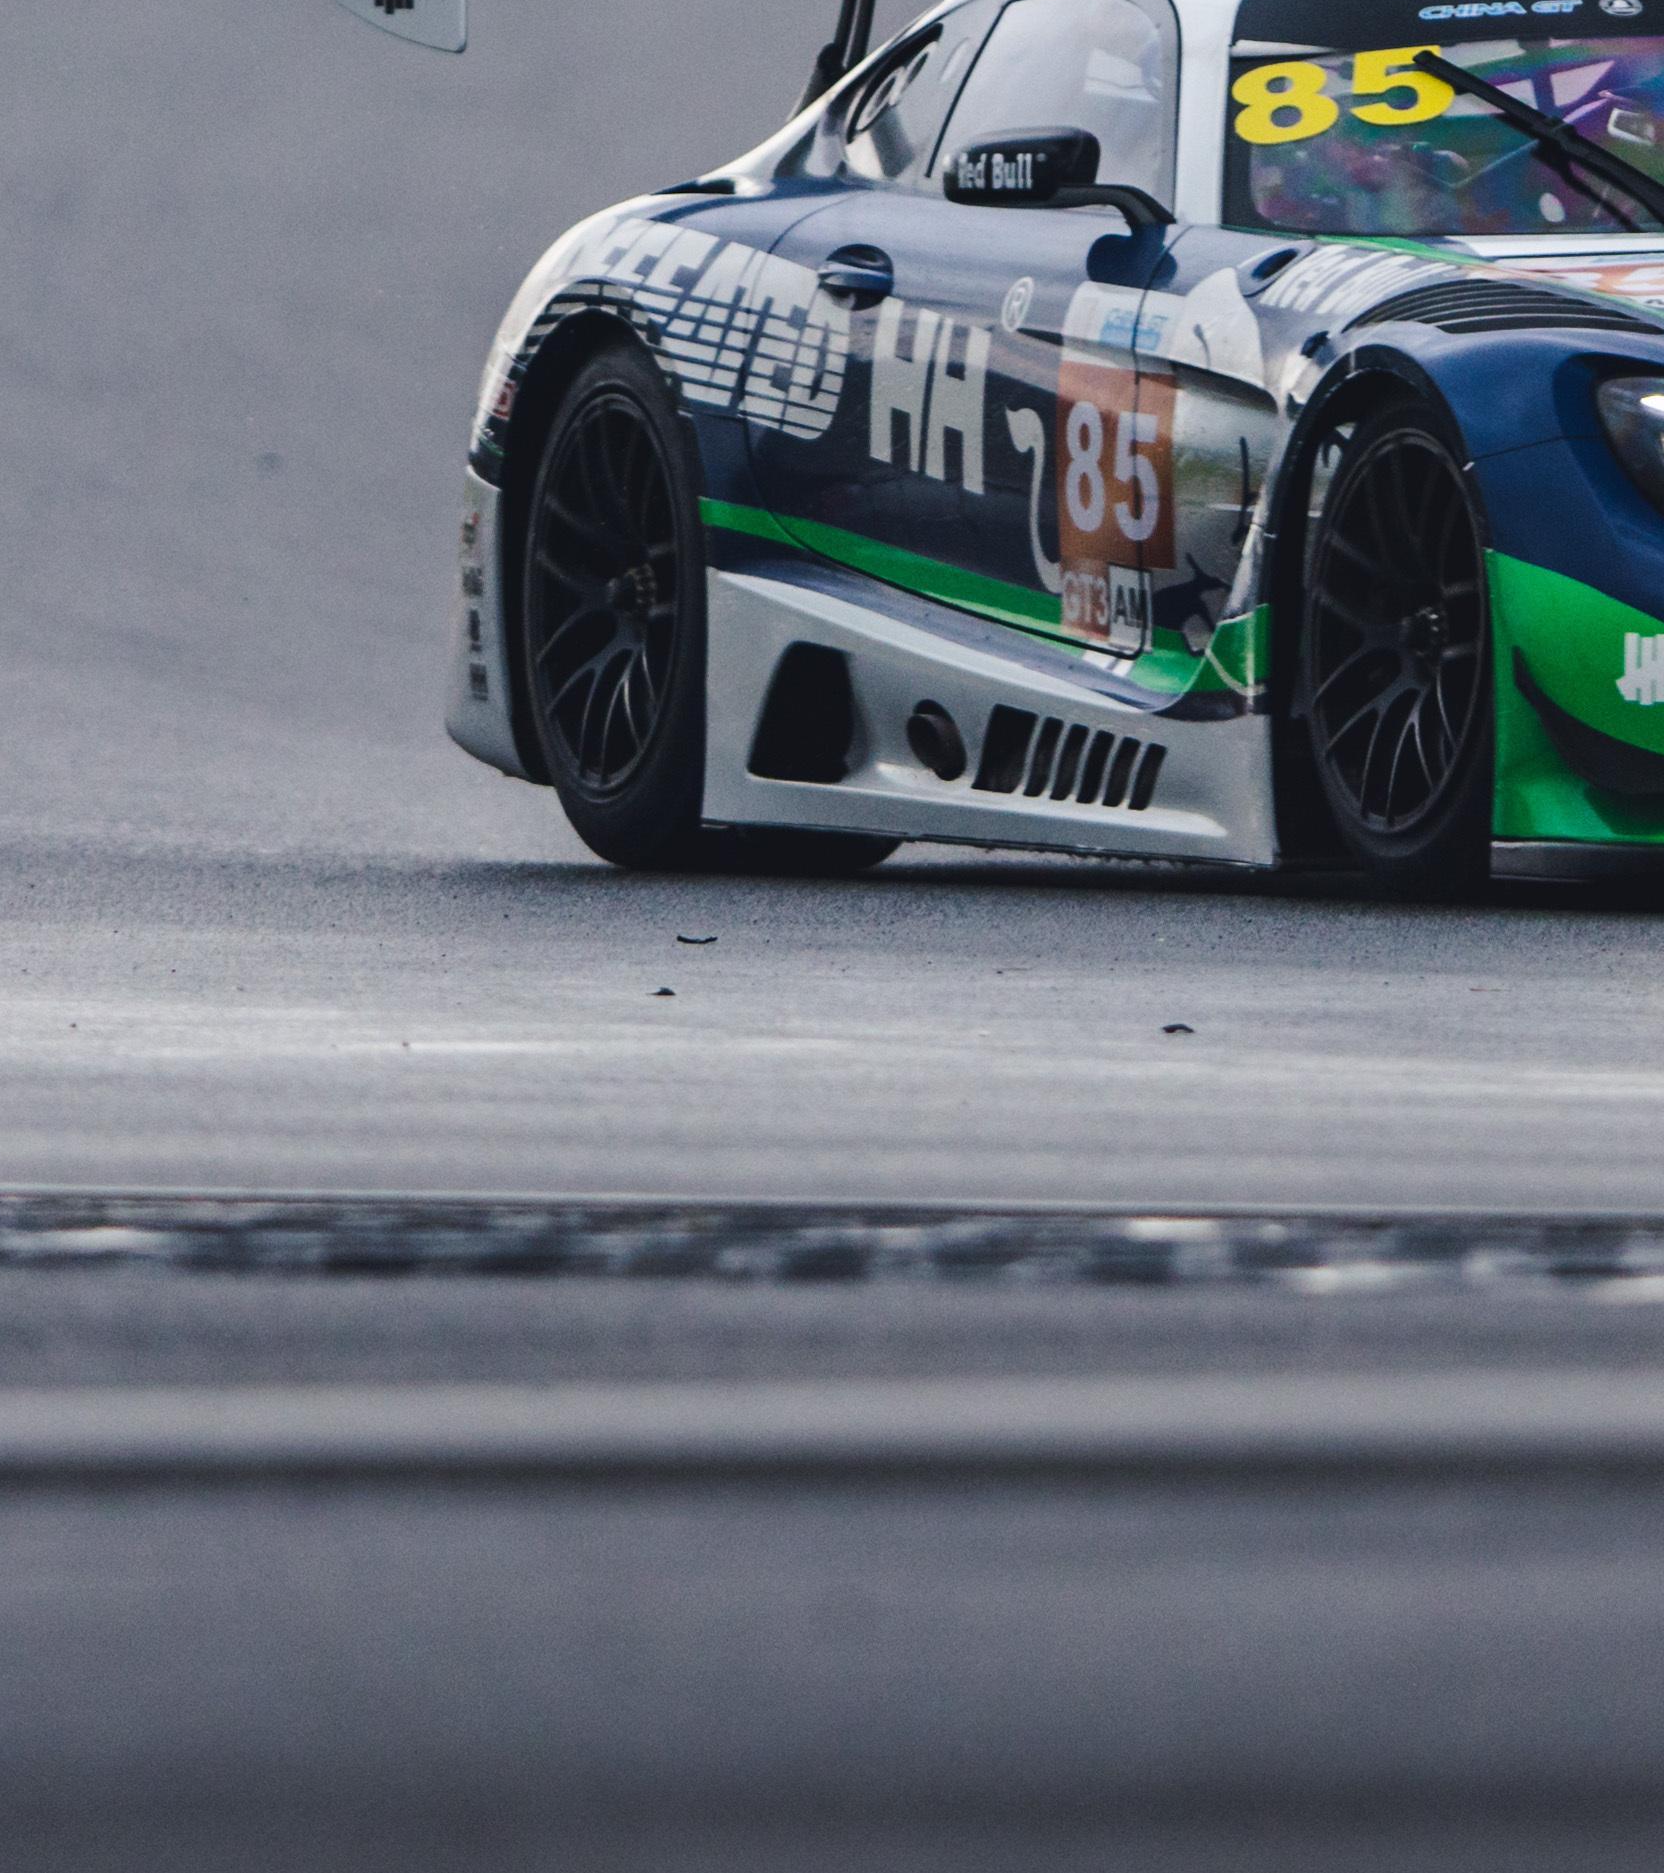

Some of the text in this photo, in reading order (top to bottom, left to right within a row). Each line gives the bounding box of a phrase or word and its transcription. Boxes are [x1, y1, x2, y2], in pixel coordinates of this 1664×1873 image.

[1418, 0, 1583, 20] CHINA GT
[1231, 44, 1456, 145] 85
[991, 152, 1033, 190] Bull
[1065, 400, 1160, 542] 85
[1062, 570, 1110, 627] GT3
